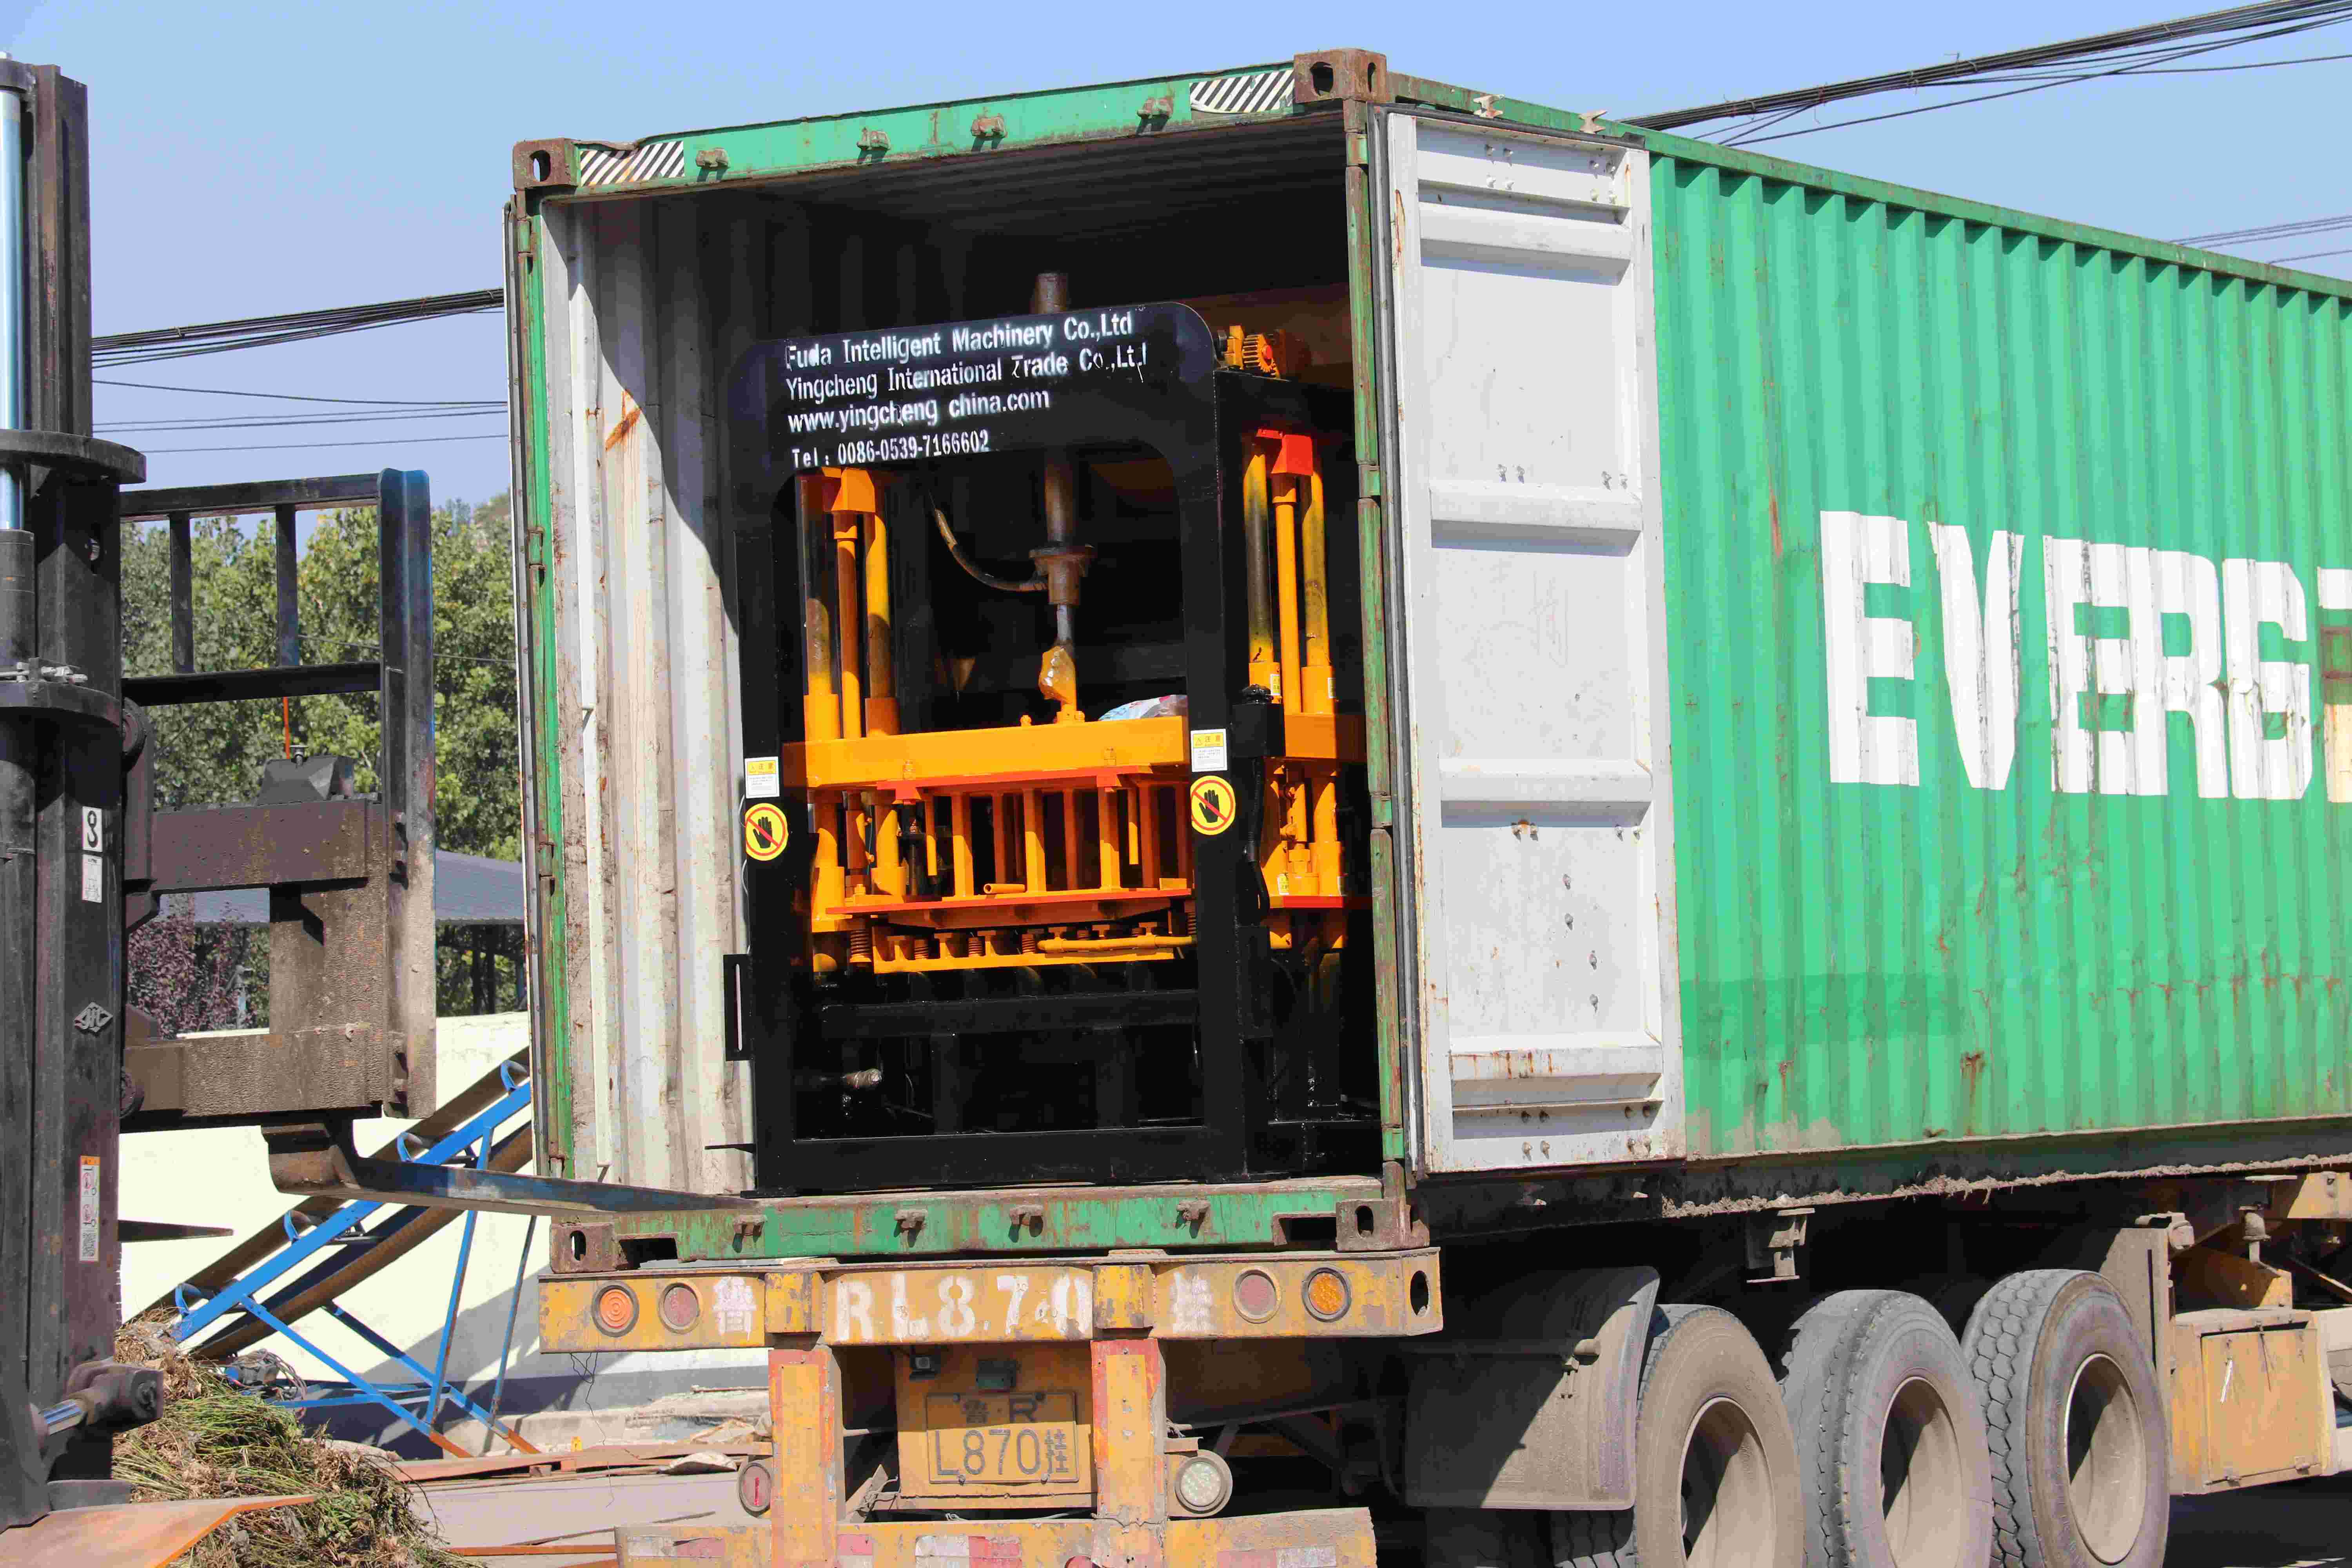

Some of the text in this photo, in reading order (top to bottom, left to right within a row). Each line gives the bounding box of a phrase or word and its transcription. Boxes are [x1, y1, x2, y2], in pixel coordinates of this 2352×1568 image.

[785, 312, 1132, 371] Fuda Intelligent Machinery Co.,Ltd
[786, 374, 877, 404] Yingcheng
[887, 358, 1002, 391] International
[1011, 352, 1069, 378] Trade
[838, 429, 990, 464] 0086-0539-7166602
